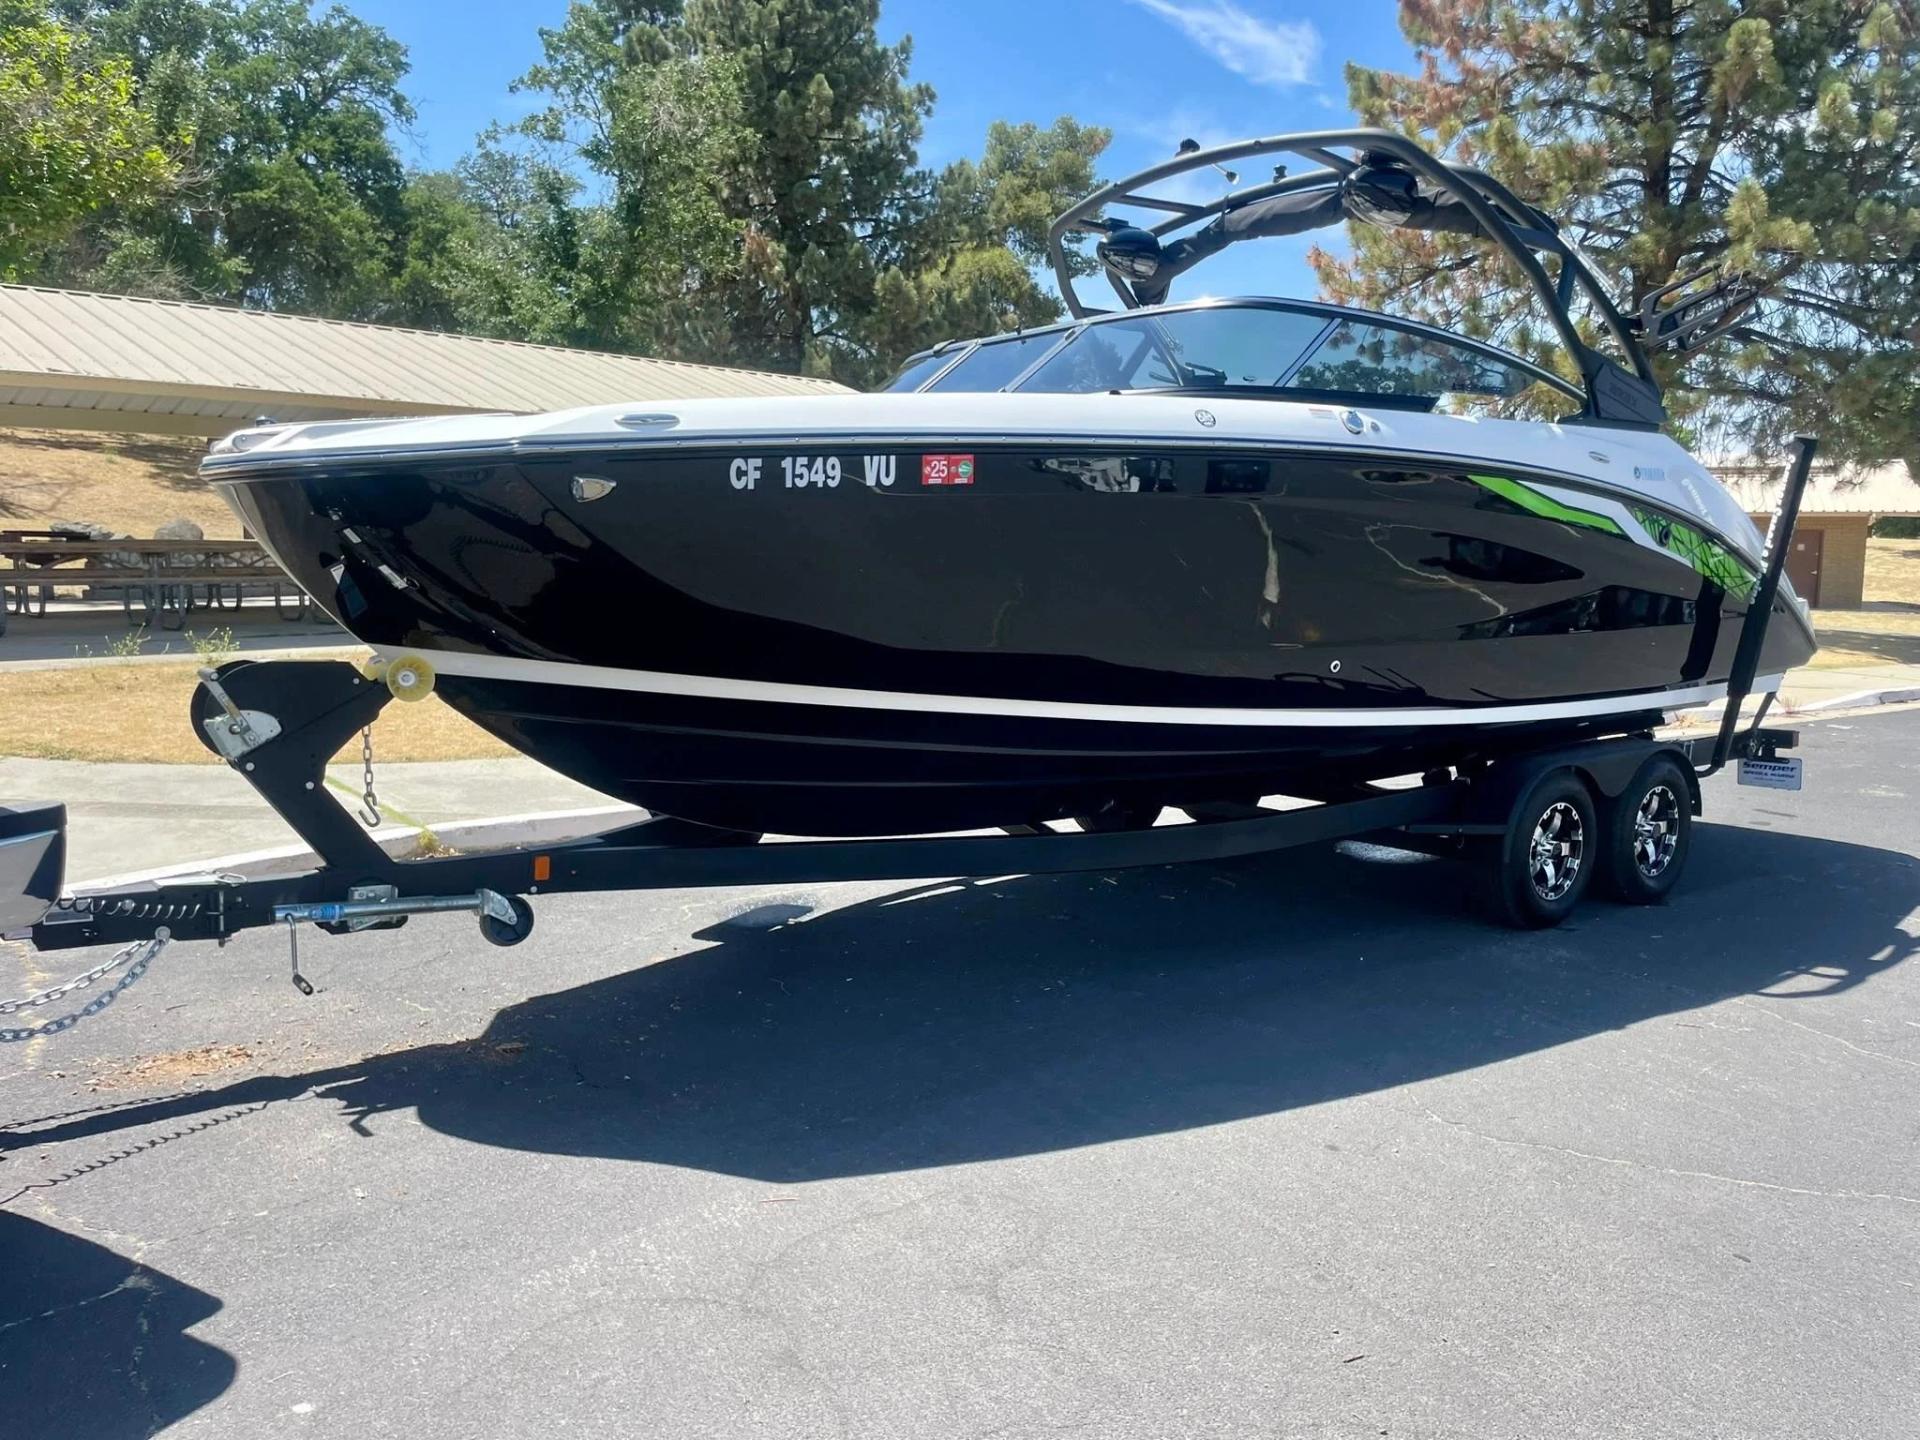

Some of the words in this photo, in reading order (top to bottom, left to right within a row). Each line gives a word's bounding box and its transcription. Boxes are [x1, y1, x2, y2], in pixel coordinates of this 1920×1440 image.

[730, 457, 762, 490] CF
[781, 455, 842, 488] 1549
[864, 454, 897, 487] VU
[931, 460, 948, 477] 25
